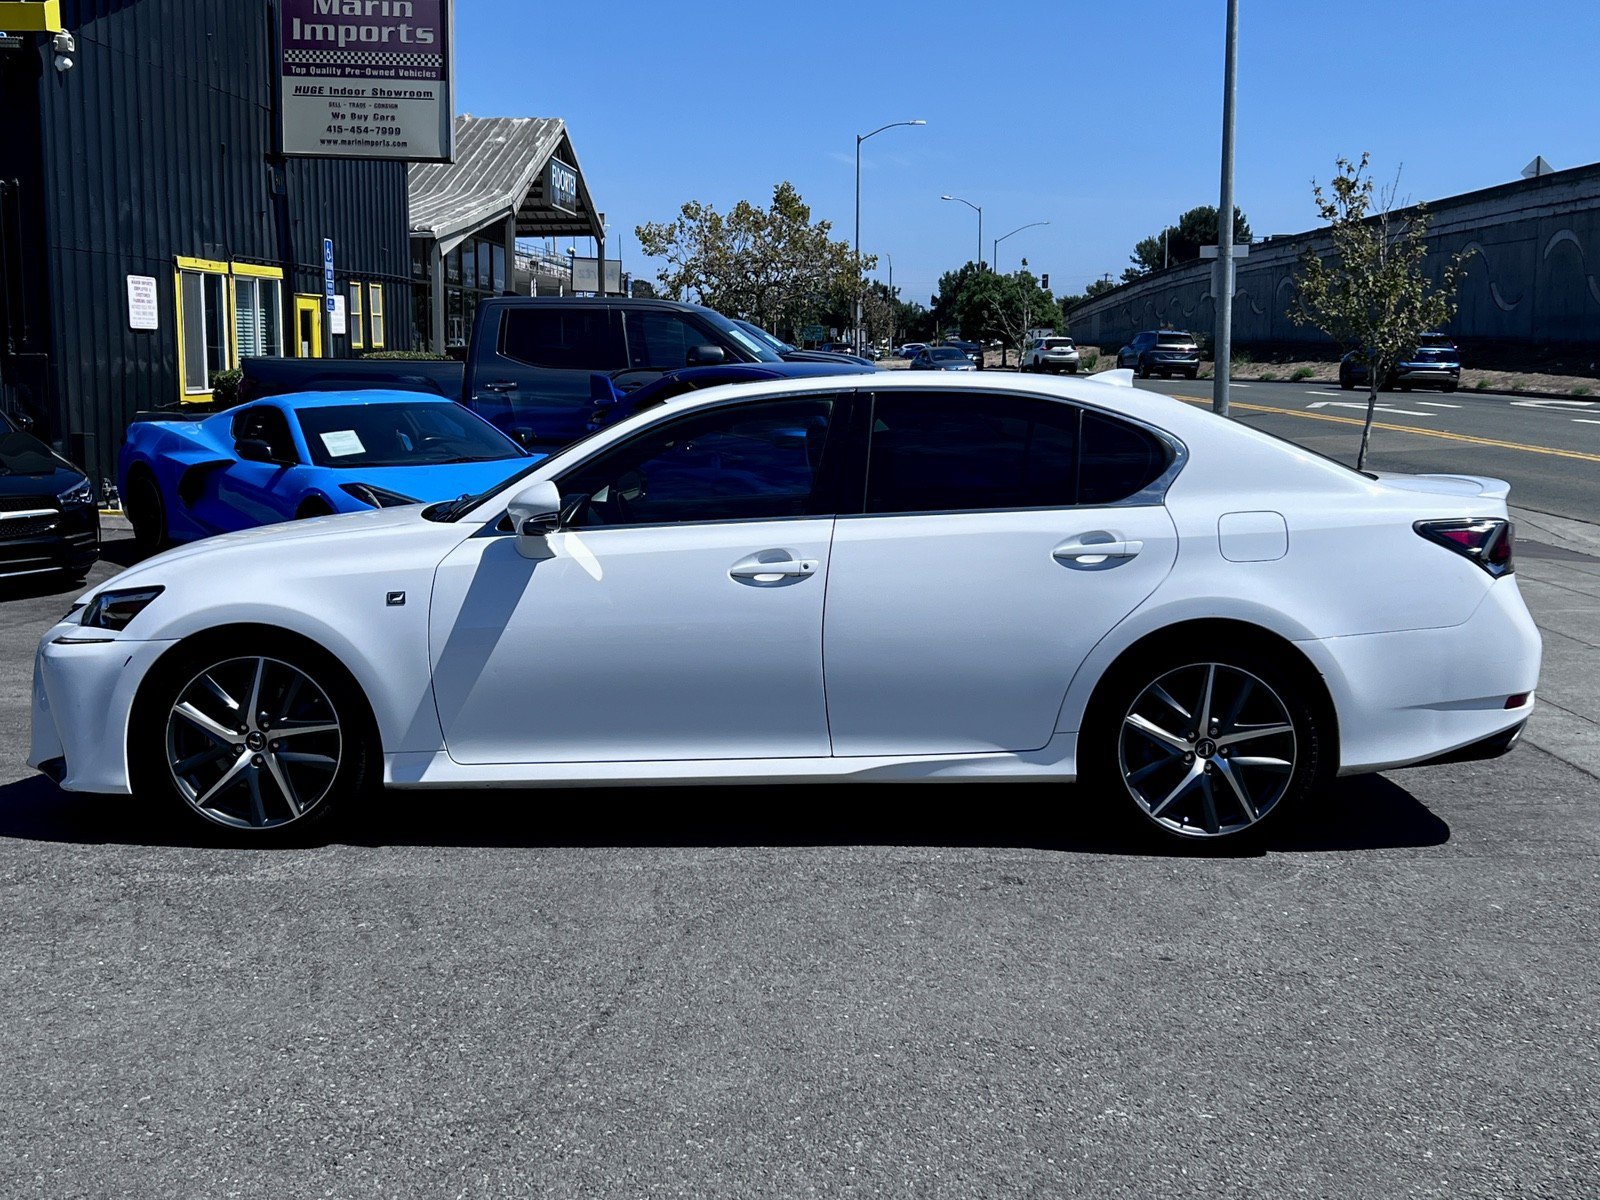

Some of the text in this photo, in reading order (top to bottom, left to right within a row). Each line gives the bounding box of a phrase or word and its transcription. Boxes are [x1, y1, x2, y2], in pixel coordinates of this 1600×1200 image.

[313, 0, 413, 17] Marin
[293, 17, 434, 48] Imports
[291, 65, 437, 78] Top Quality Pre-Owned Vehicles
[294, 85, 433, 98] HUGE Indoor Showroom
[331, 111, 396, 121] We Buy Cars
[326, 125, 401, 136] 415-454-7999
[319, 138, 408, 148] www.marinimports.com
